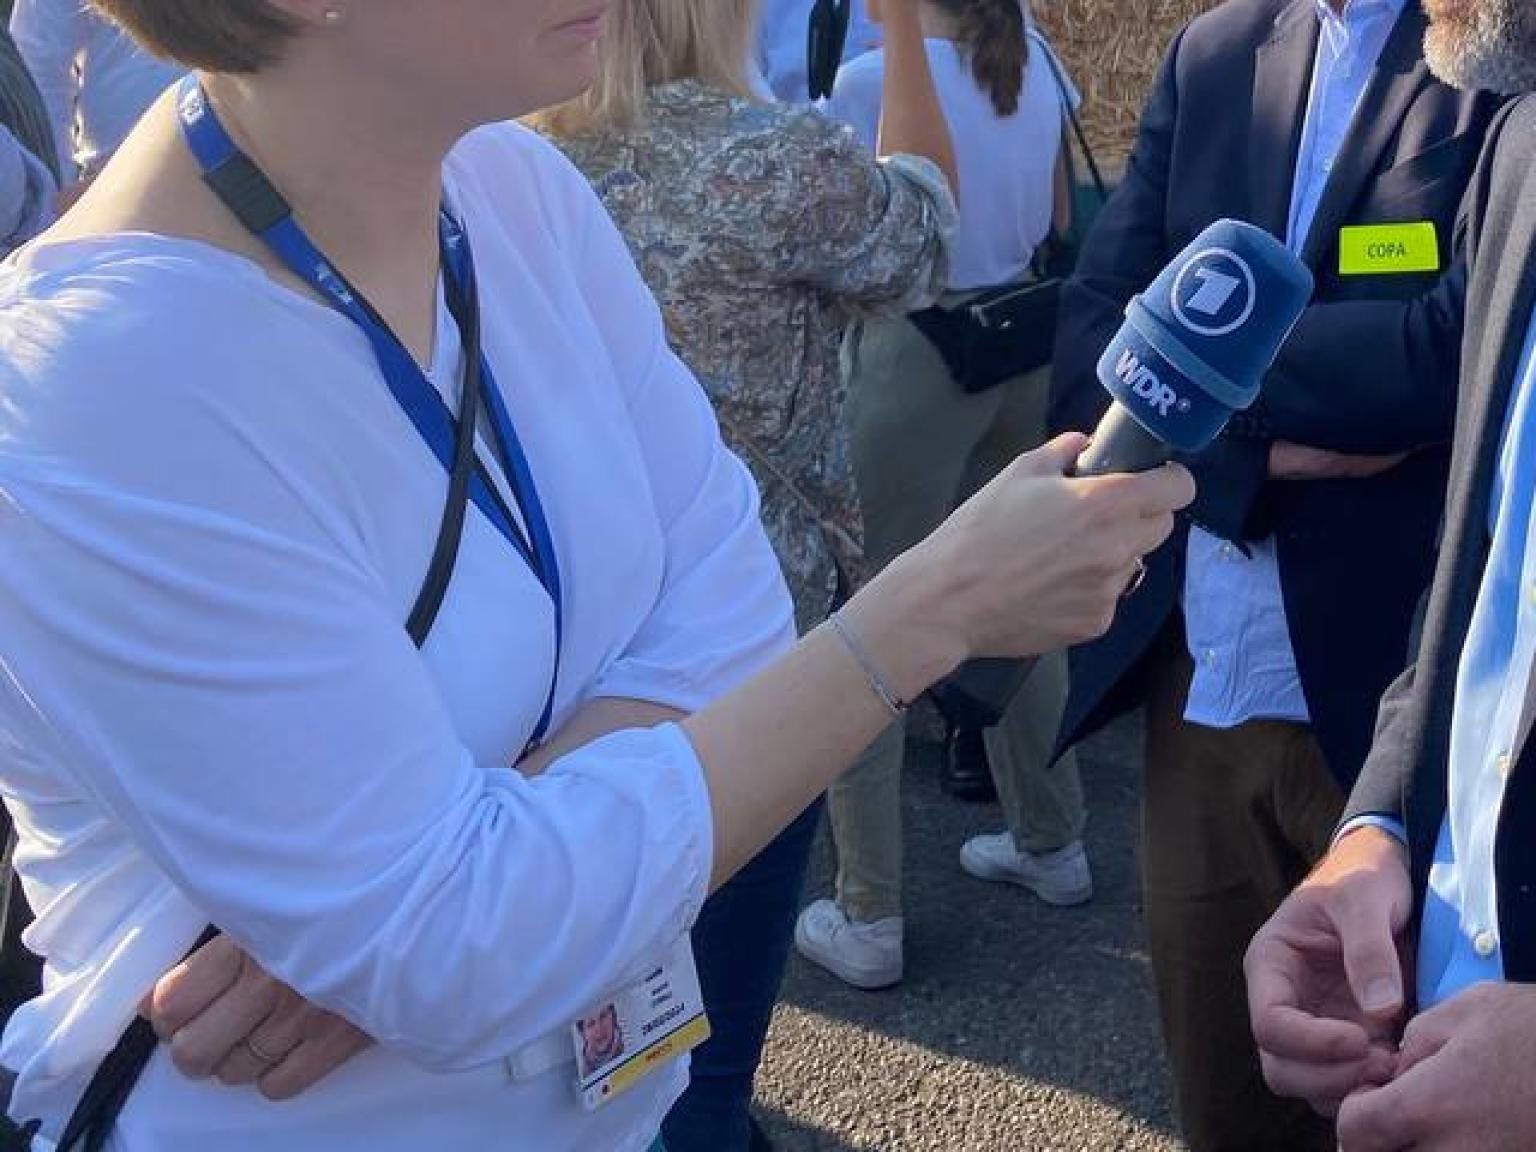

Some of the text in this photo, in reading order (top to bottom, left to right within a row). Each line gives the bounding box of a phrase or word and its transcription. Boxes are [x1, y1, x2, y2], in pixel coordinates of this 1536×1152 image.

[1367, 241, 1406, 258] COPA
[1184, 267, 1242, 316] 1
[1115, 348, 1177, 418] WDR
